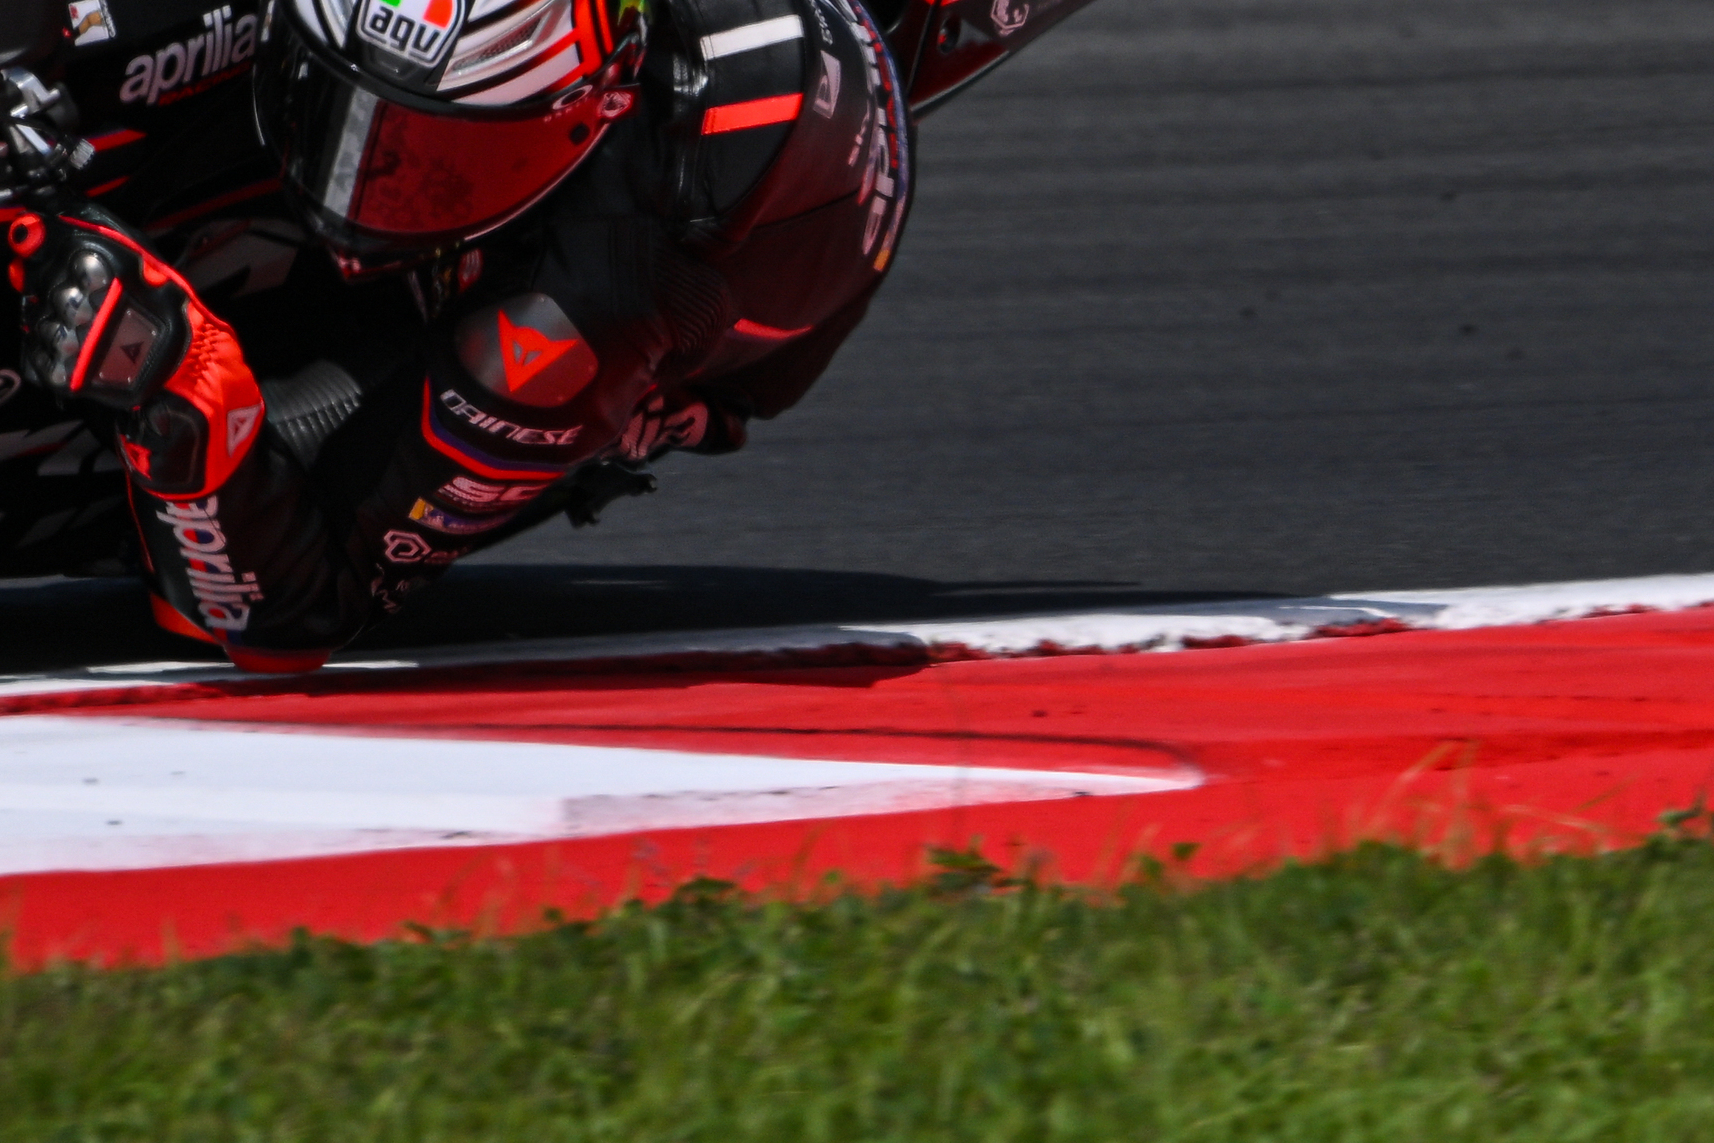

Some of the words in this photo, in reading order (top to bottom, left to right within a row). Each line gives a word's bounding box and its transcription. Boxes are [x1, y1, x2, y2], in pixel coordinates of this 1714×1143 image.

[118, 4, 259, 107] aprilia
[369, 7, 441, 61] agv
[440, 388, 585, 447] DAINESE
[158, 495, 266, 633] aprilia
